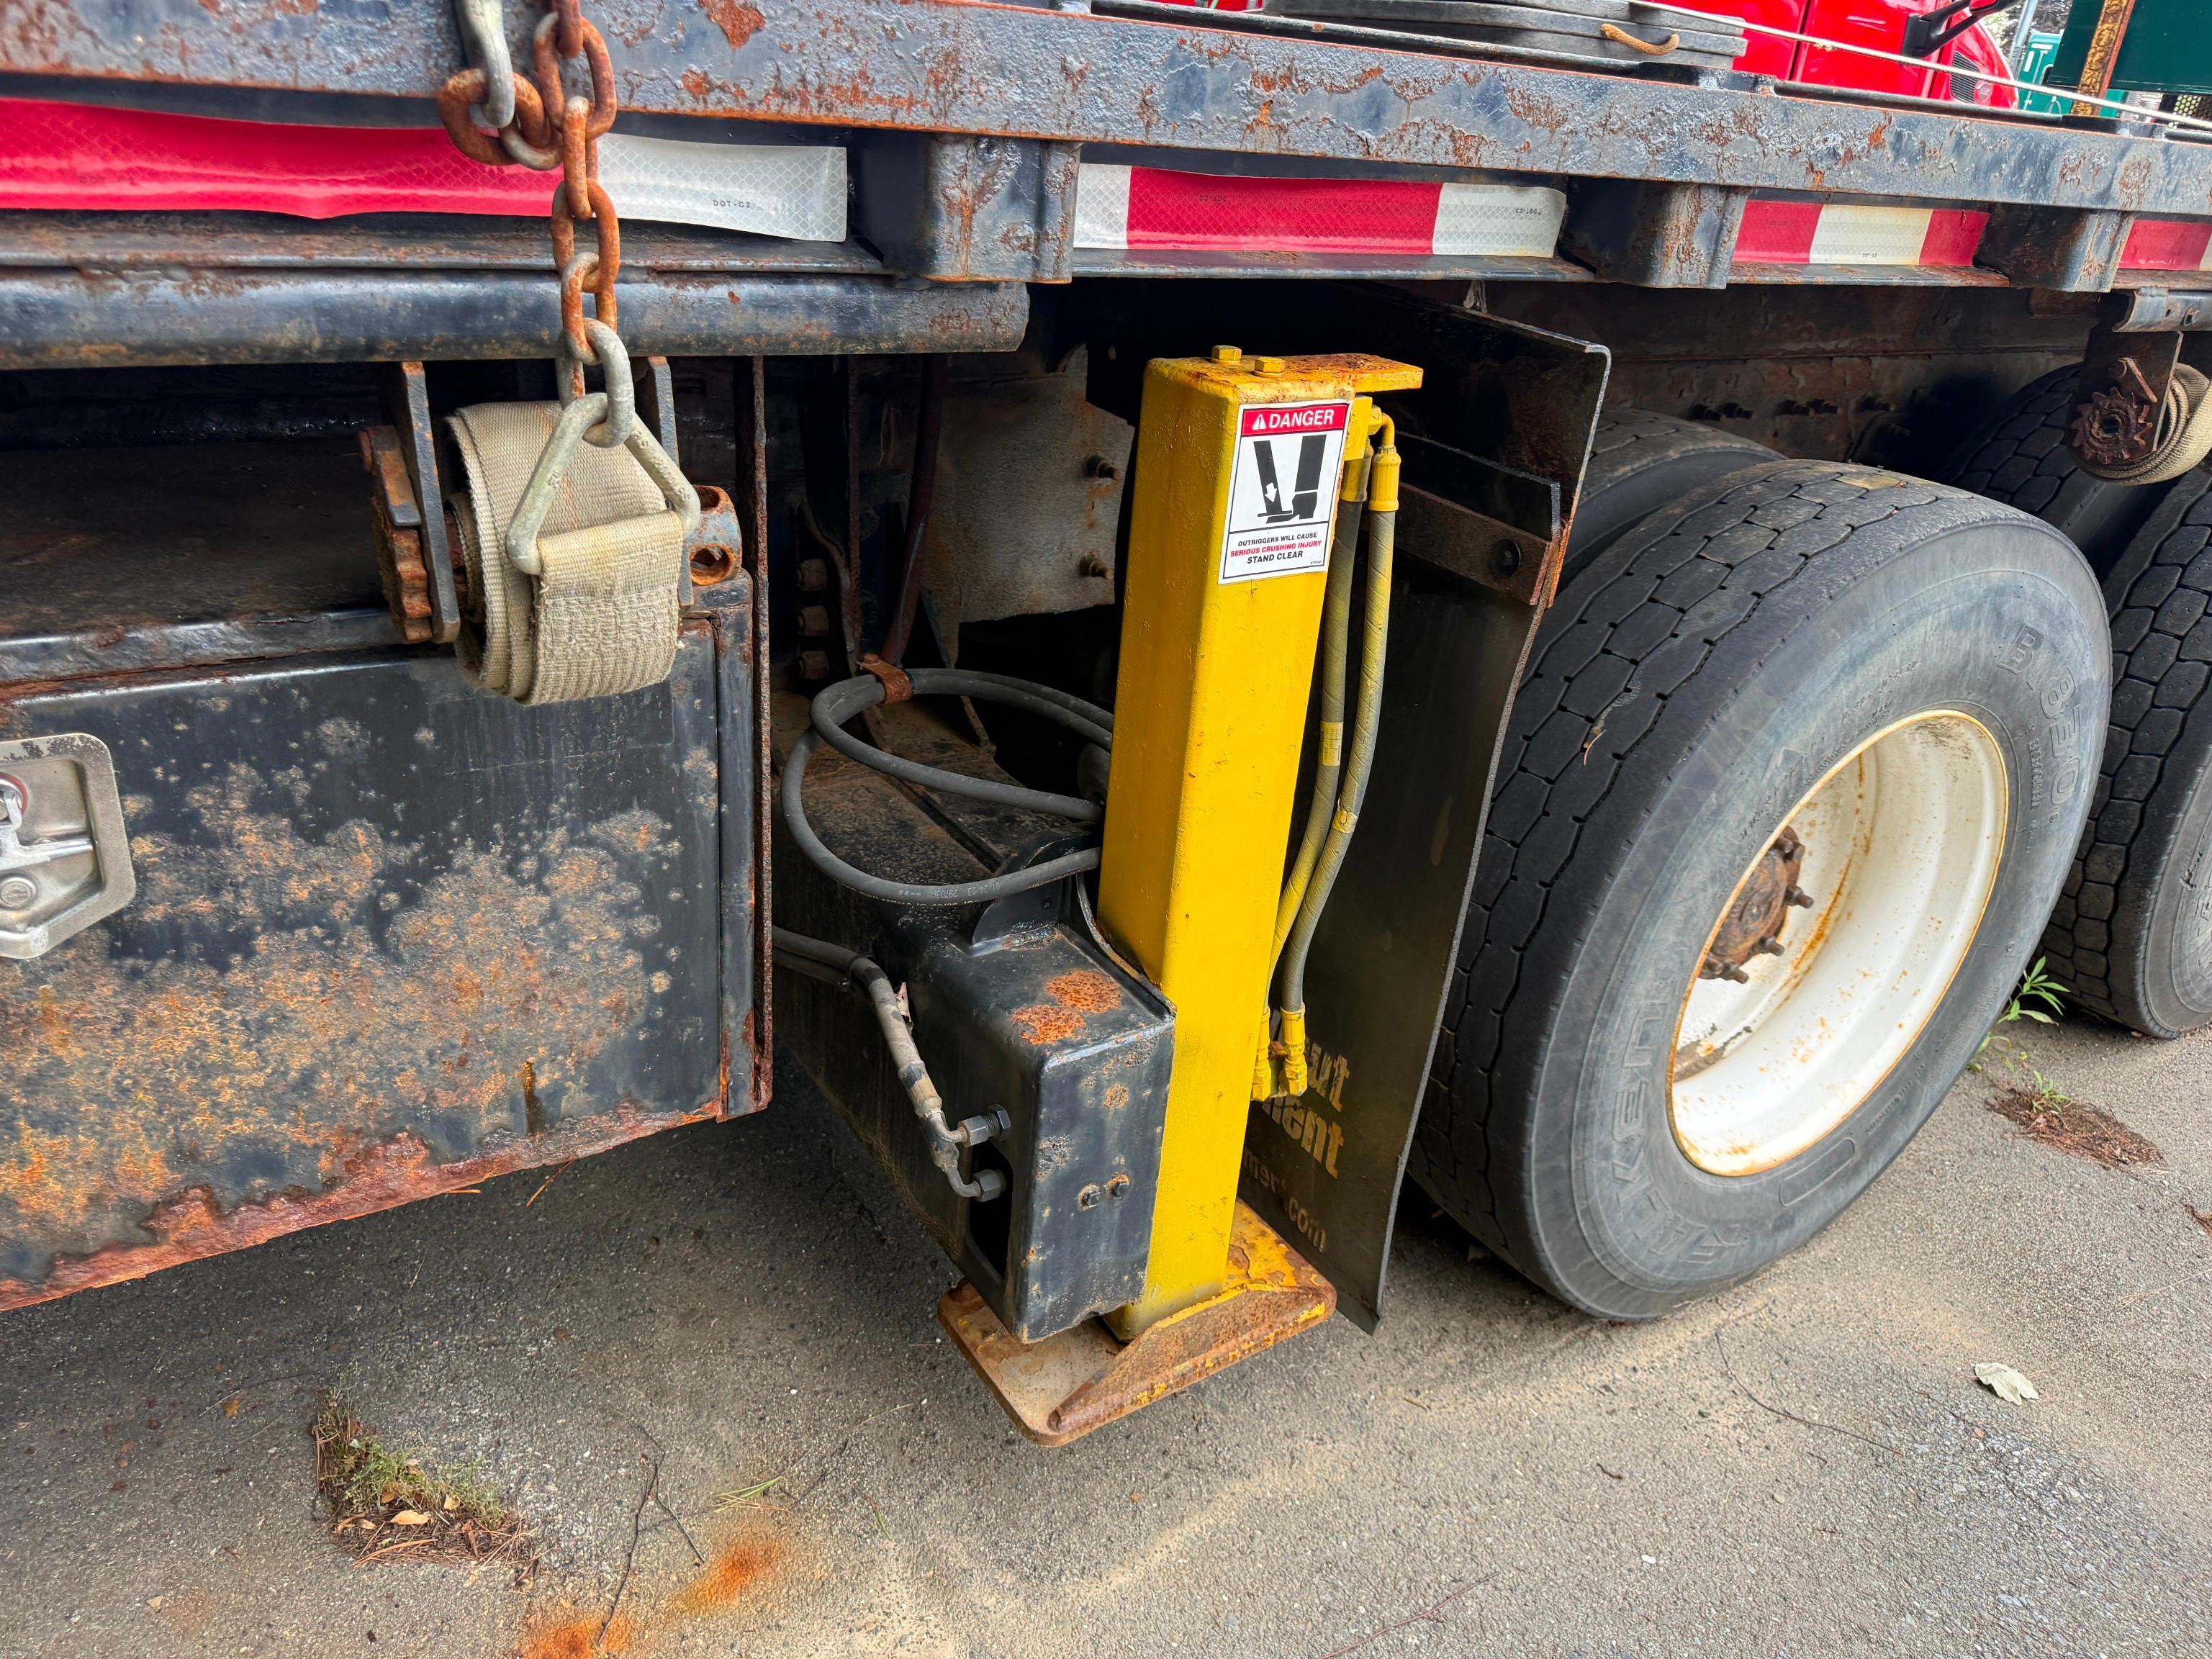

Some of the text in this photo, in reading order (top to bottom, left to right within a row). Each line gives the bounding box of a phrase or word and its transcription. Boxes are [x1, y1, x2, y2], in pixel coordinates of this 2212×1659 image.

[713, 199, 751, 209] DOT-C2
[1268, 410, 1334, 429] DANGER
[1237, 537, 1279, 547] OUTRIGGERS
[1230, 541, 1322, 557] SERIOUS CRUSHING INJURY
[1247, 551, 1304, 564] STAND CLEAR
